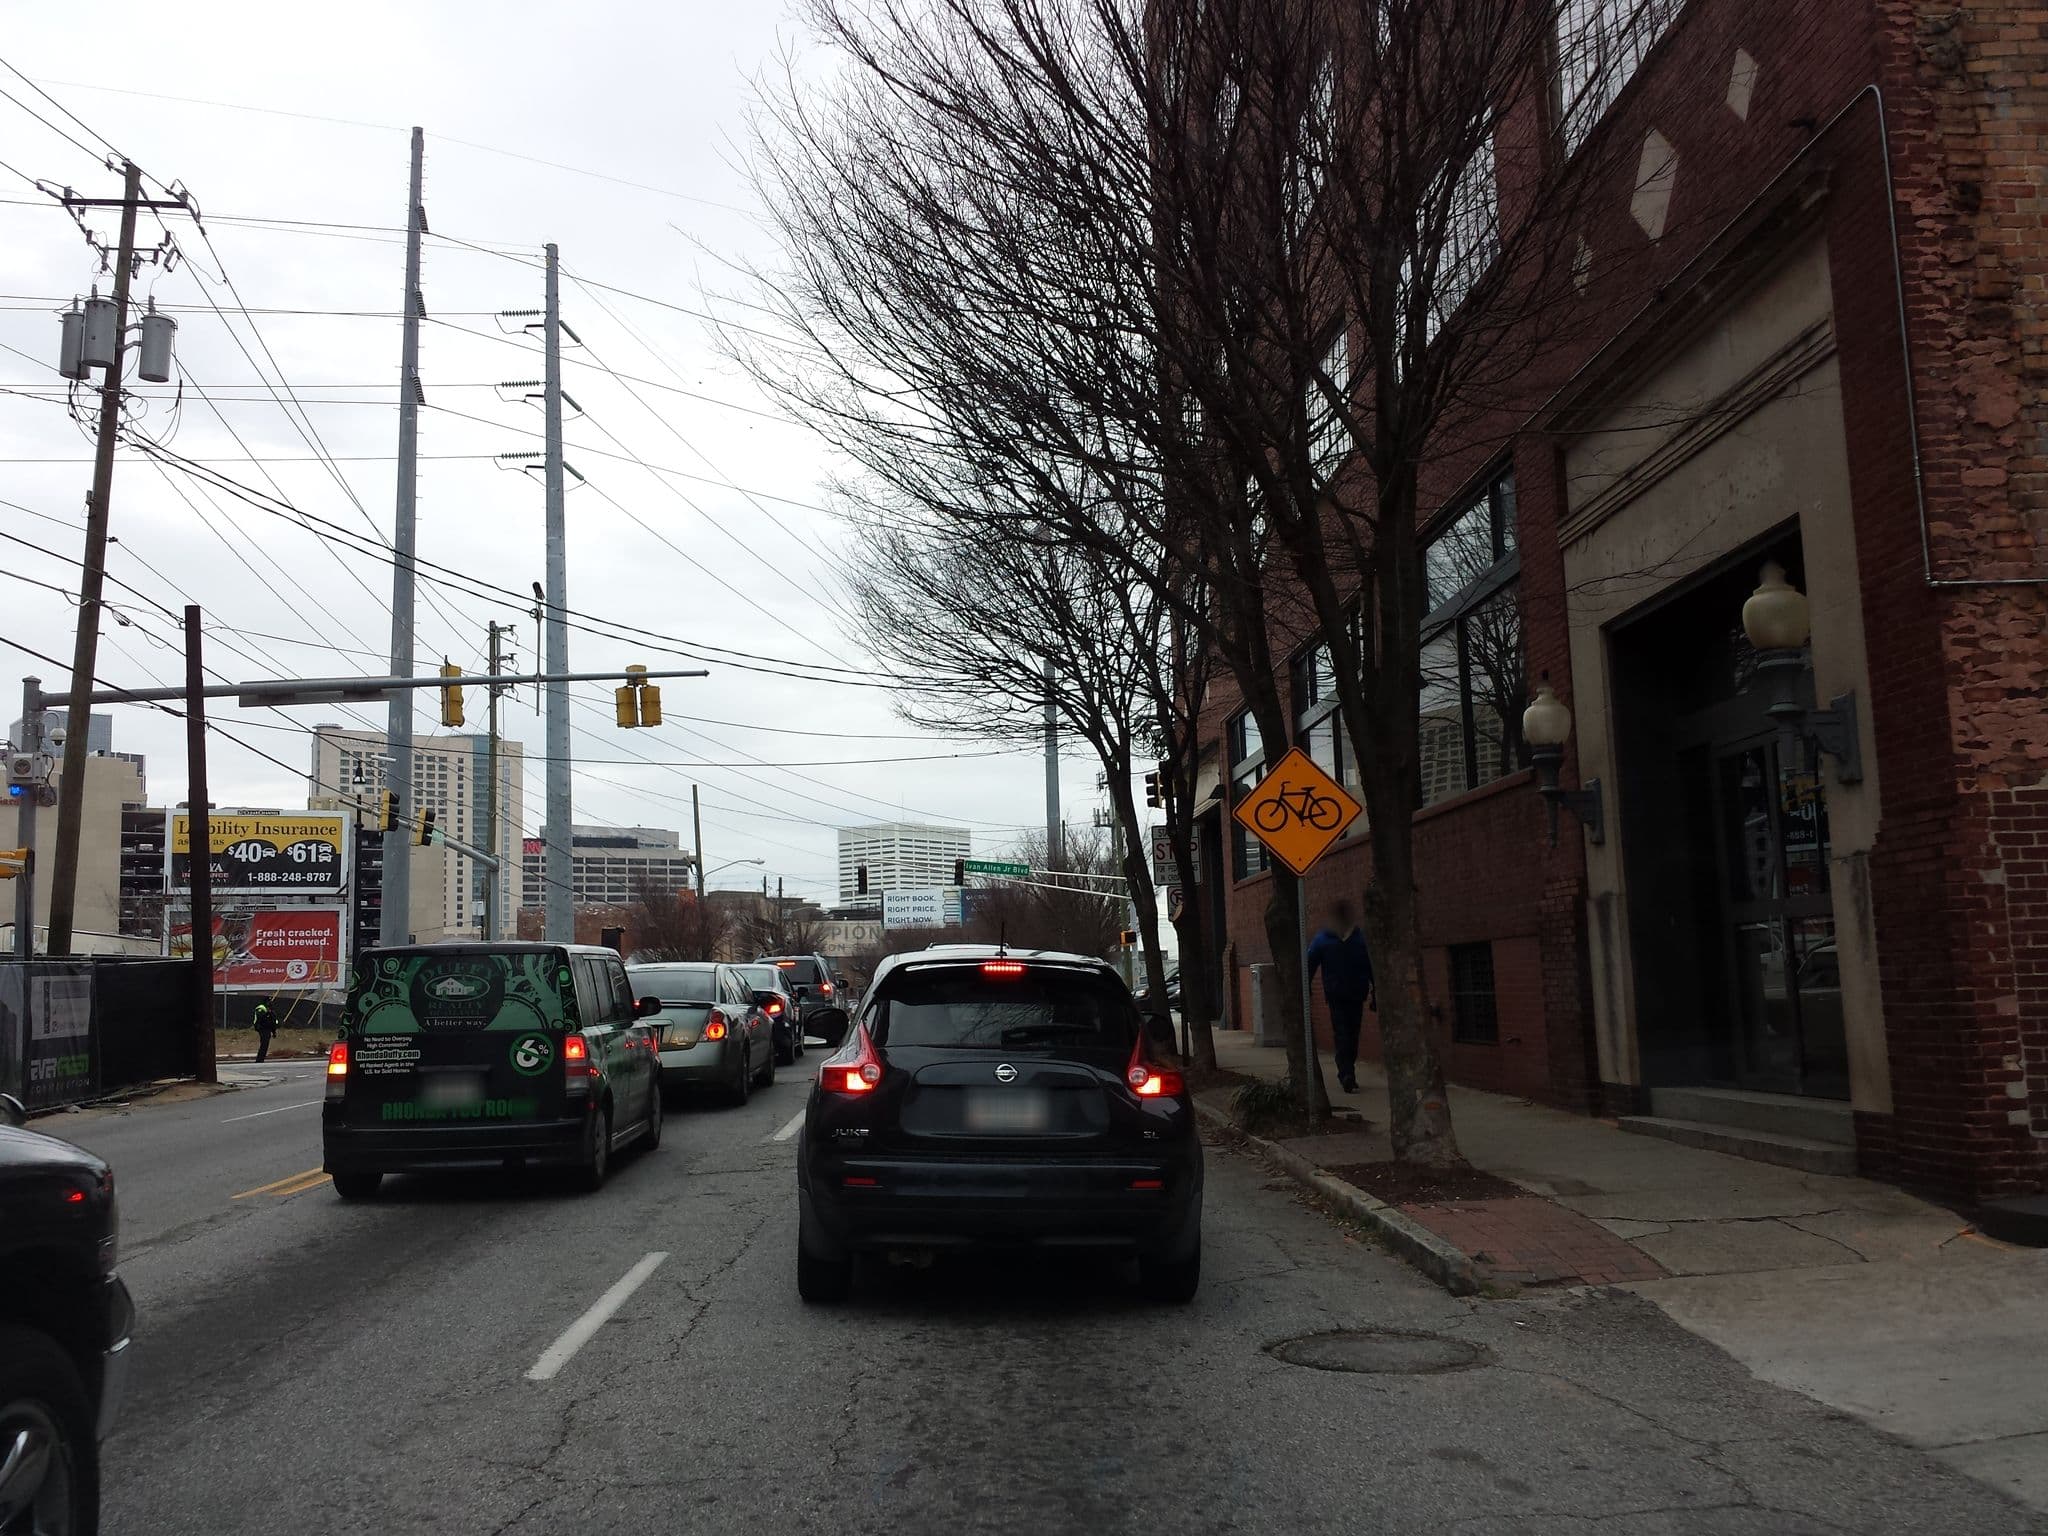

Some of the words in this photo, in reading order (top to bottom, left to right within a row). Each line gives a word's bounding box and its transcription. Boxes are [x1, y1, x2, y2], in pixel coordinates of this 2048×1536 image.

[178, 821, 250, 837] Lbility
[255, 821, 338, 836] Insurance
[213, 838, 225, 846] as
[228, 843, 262, 863] $40
[287, 843, 317, 863] $61
[1156, 842, 1198, 860] STP
[966, 862, 981, 870] Ivan
[982, 864, 1001, 872] Allen
[247, 872, 333, 882] 1-888-248-8787
[256, 929, 285, 938] Fresh
[288, 928, 333, 938] cracked.
[255, 938, 285, 947] Fresh
[288, 938, 330, 947] brewed.
[831, 1128, 871, 1137] JUKE
[1143, 1130, 1160, 1139] SL
